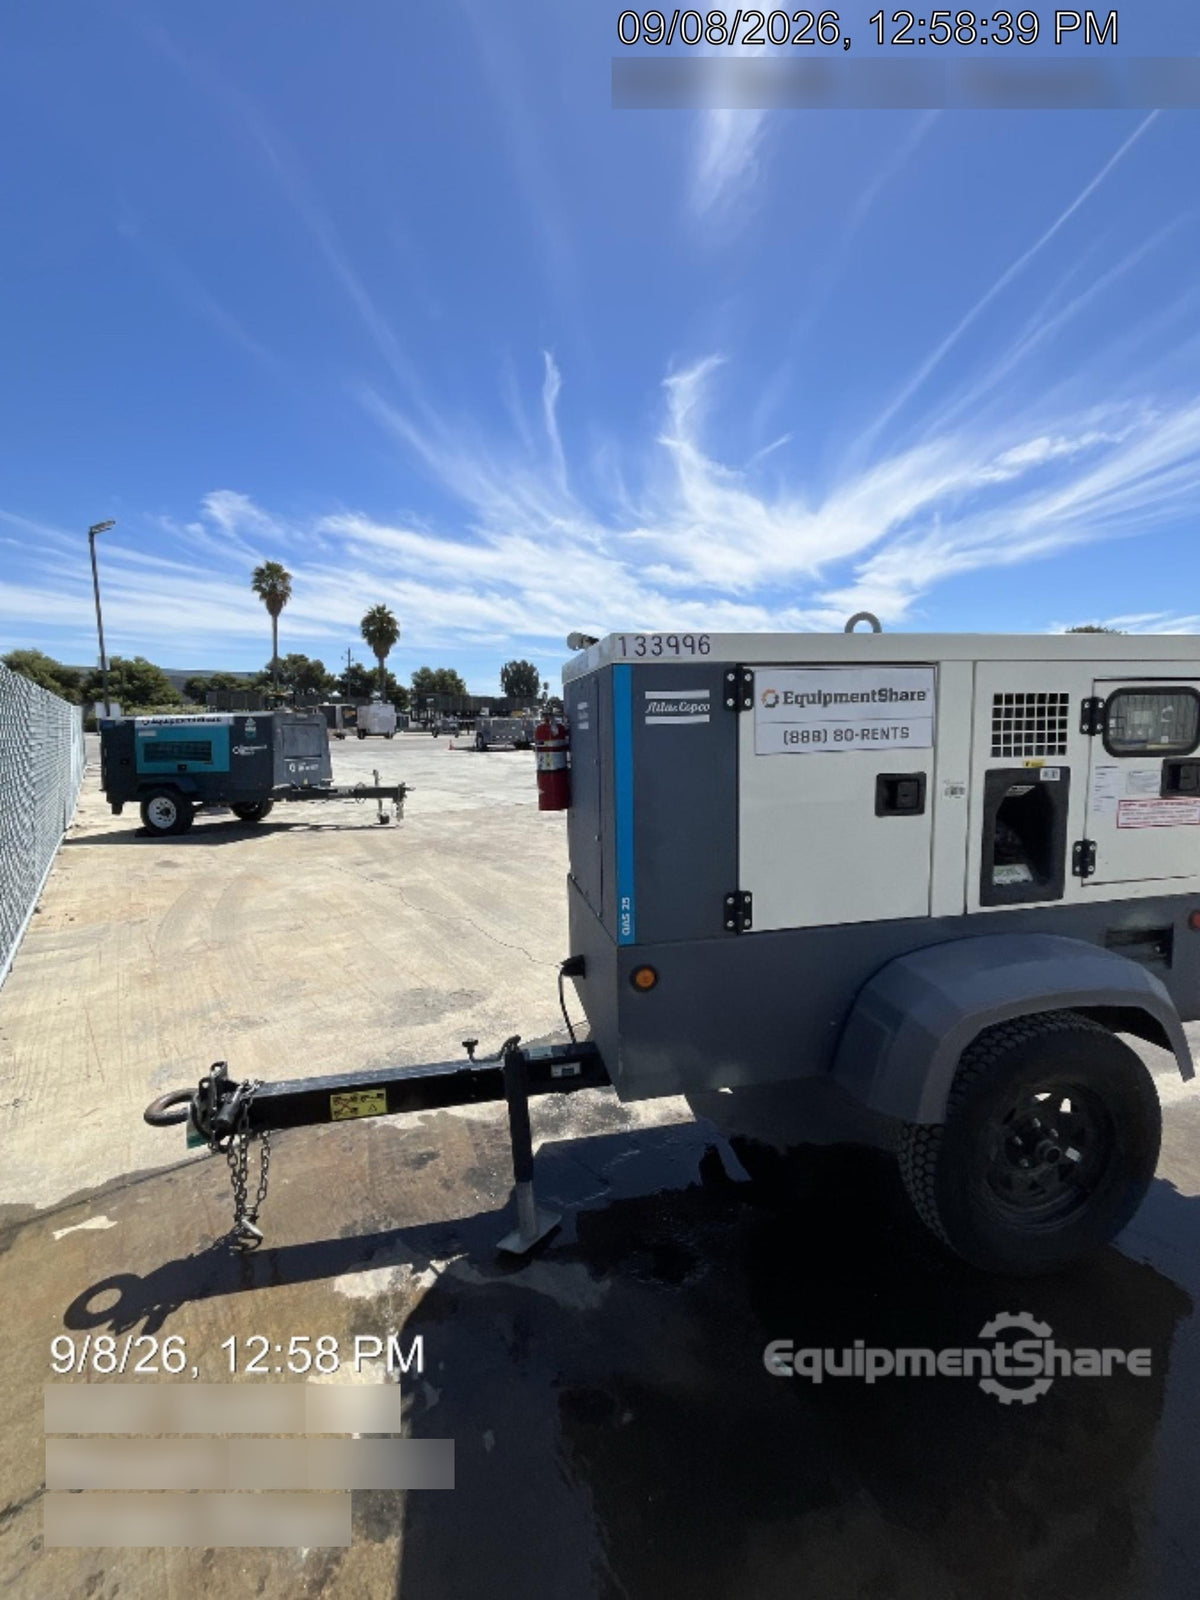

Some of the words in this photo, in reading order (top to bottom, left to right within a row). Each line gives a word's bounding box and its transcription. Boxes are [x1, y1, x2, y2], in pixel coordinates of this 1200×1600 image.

[618, 633, 711, 657] 133996
[782, 687, 927, 708] EquipmentShare
[783, 729, 828, 746] (888)
[833, 726, 910, 742] 80-RENTS
